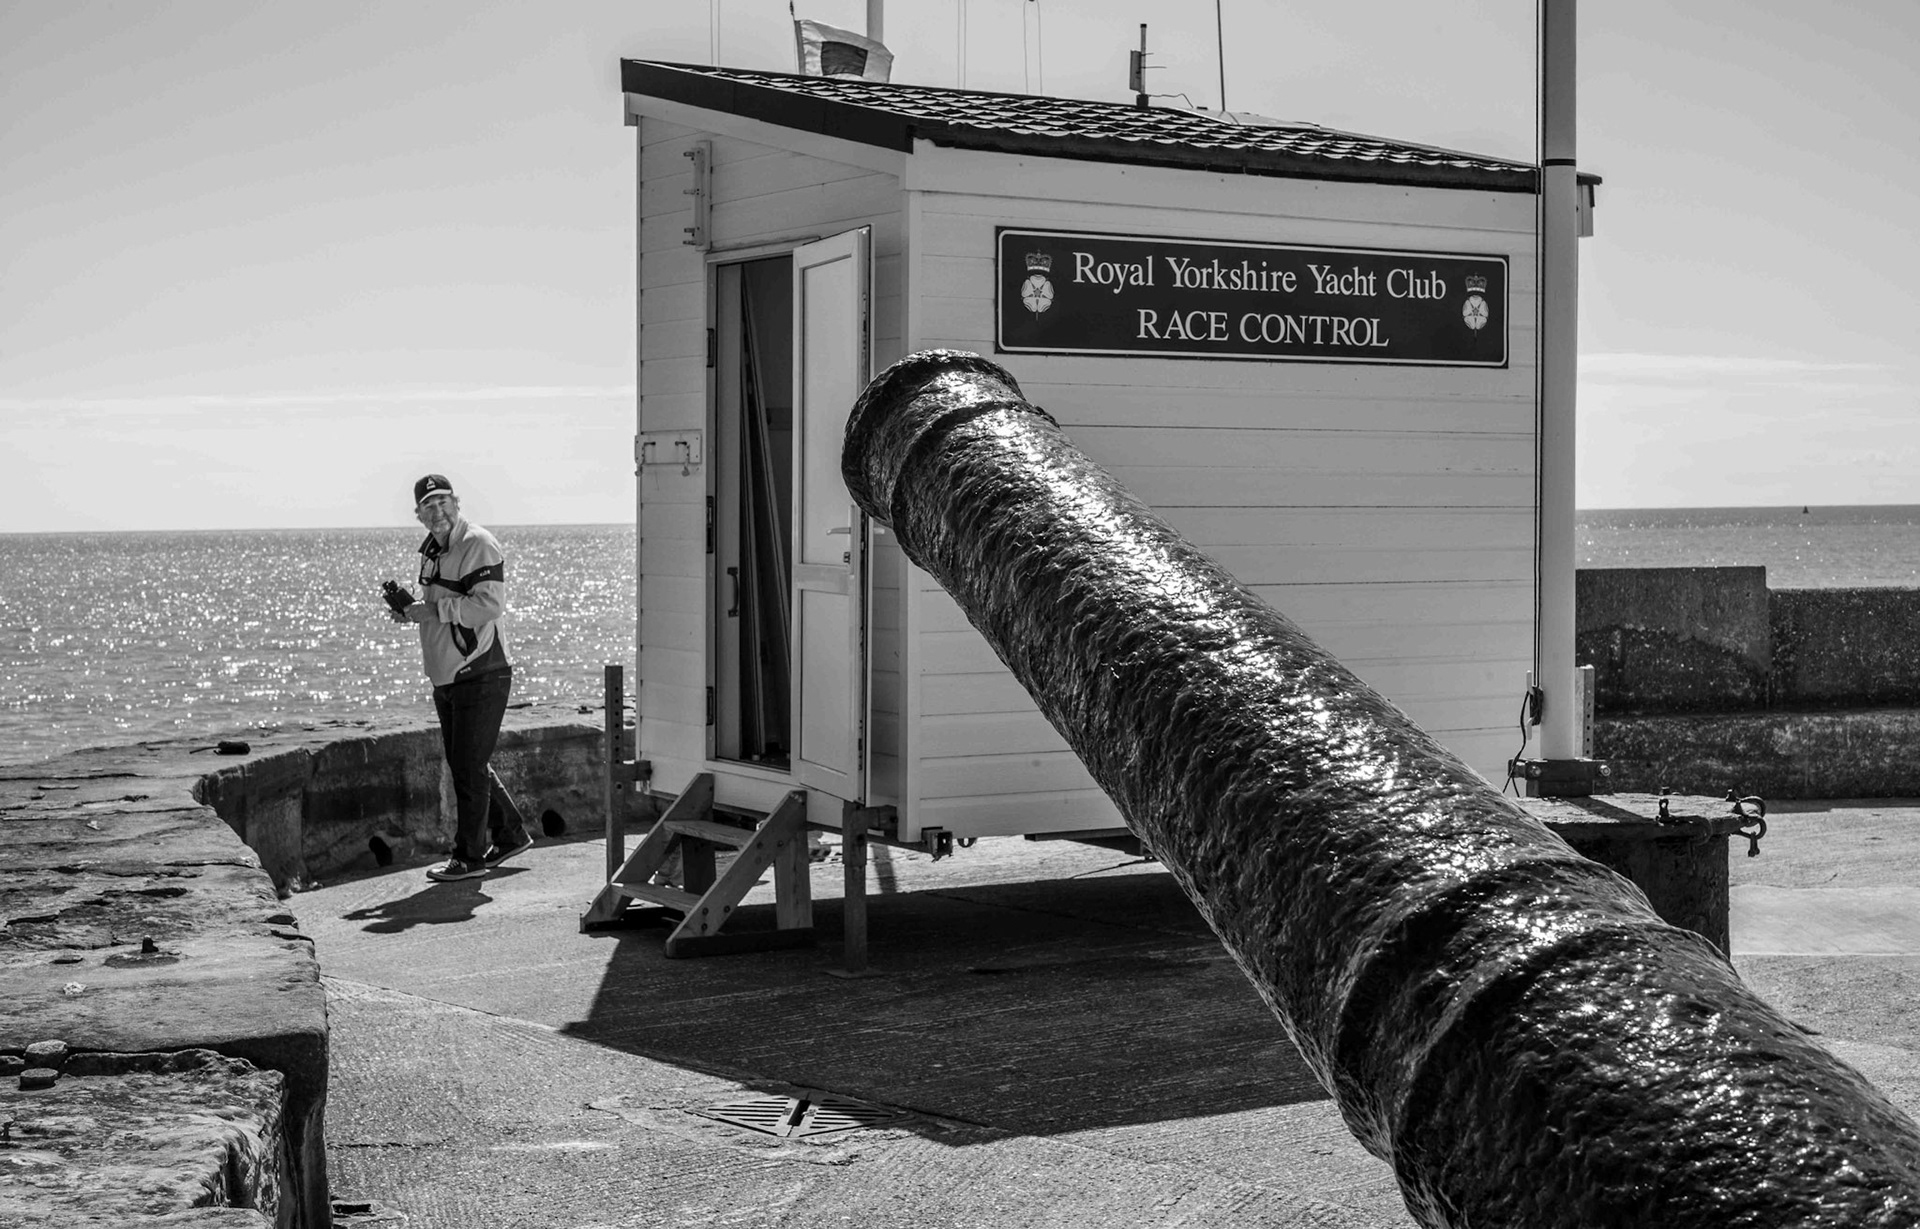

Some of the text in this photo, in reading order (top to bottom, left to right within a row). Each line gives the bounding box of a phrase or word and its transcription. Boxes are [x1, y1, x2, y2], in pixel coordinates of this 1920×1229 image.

[1073, 252, 1446, 299] Royal Yorkshire Yacht Club
[1137, 309, 1389, 347] RACE CONTROL
